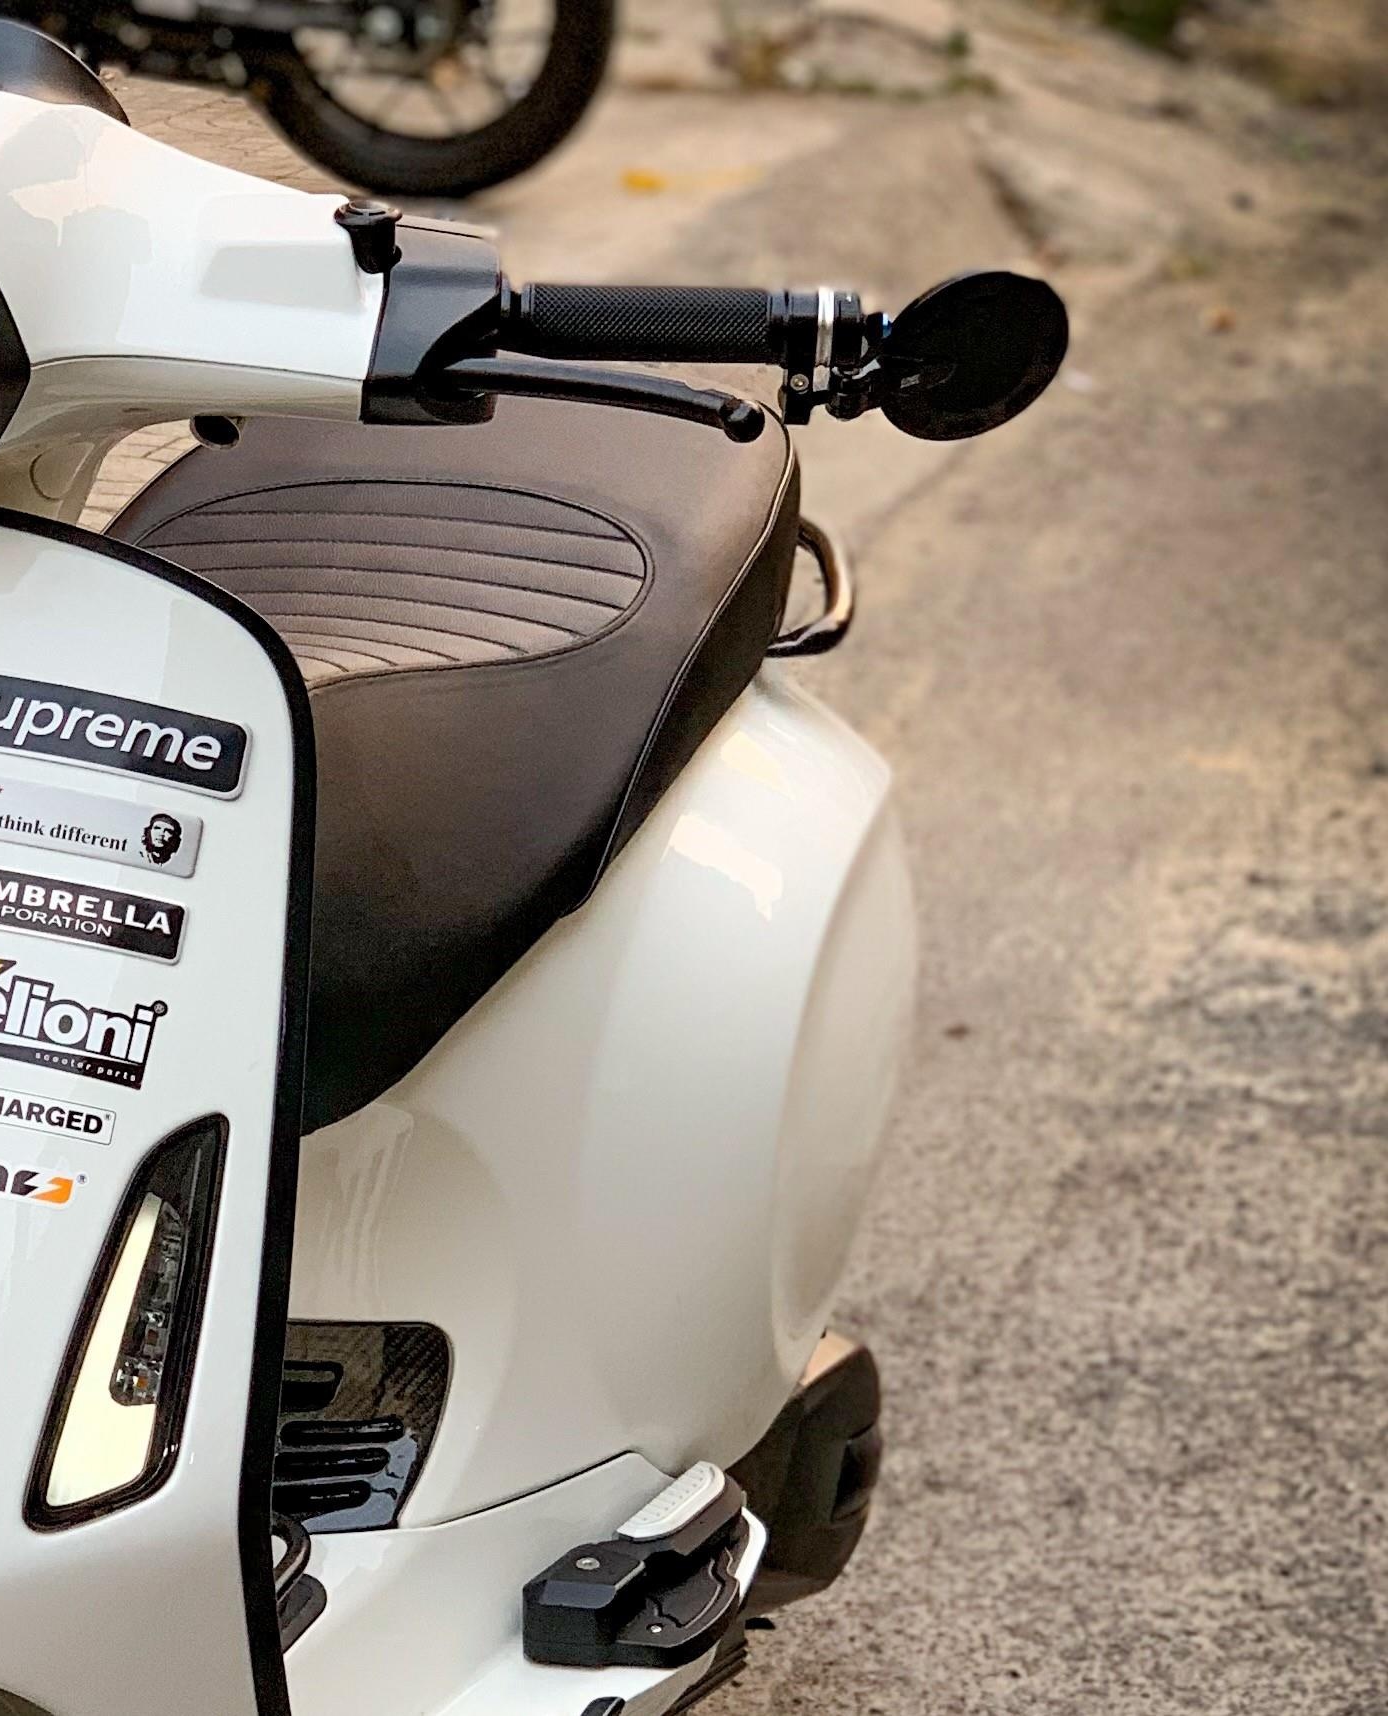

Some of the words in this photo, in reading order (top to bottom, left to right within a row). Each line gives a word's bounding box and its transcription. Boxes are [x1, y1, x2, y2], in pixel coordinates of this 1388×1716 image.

[49, 824, 128, 854] different
[35, 1052, 92, 1071] scooter
[96, 1066, 137, 1083] parts
